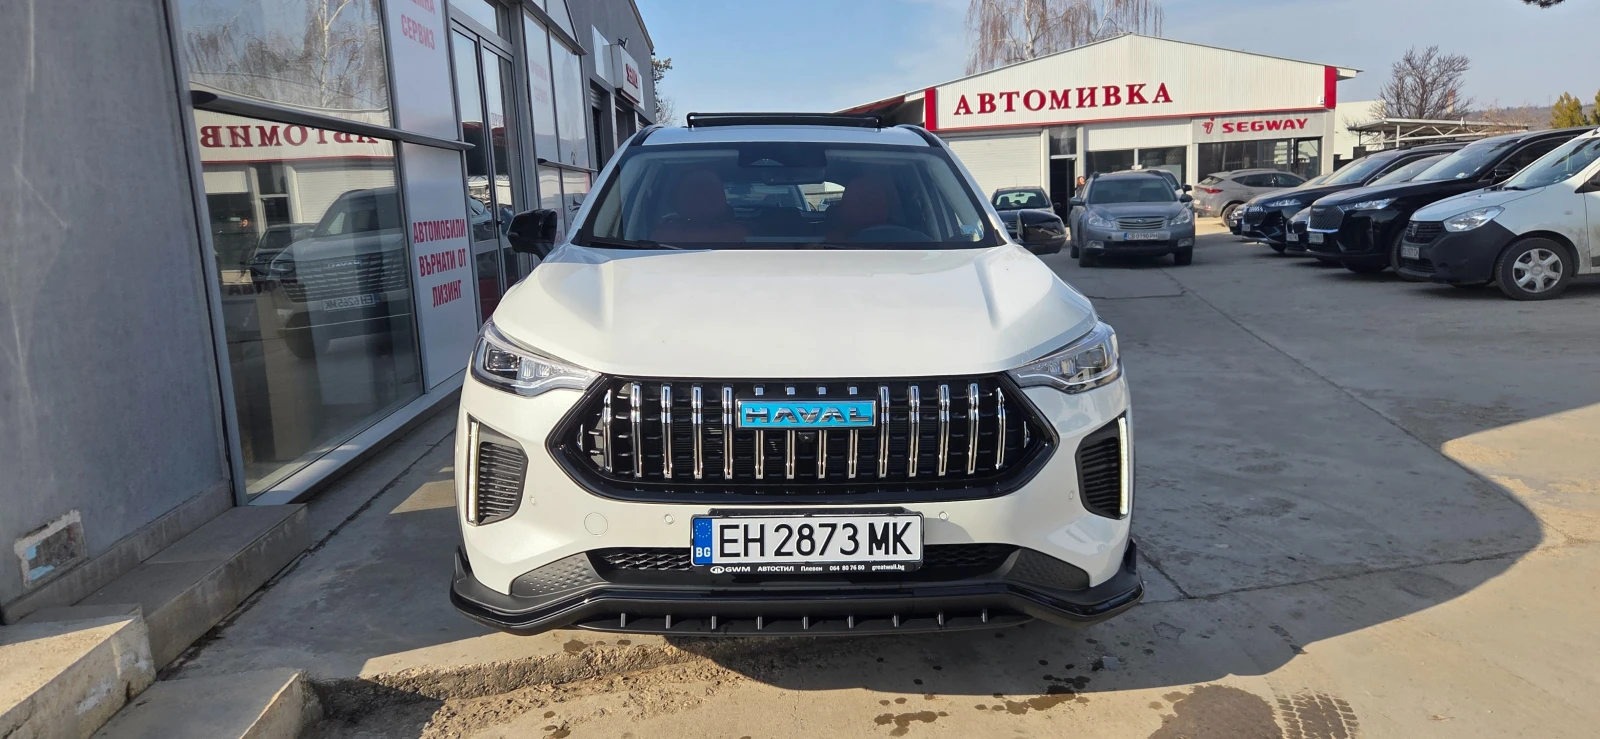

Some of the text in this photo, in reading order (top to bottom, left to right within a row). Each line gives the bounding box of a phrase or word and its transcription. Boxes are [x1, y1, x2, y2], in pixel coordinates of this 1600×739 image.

[401, 13, 435, 50] СЕРВИЗ
[954, 82, 1173, 115] АВТОМИВКА
[1222, 118, 1308, 133] SEGWAY
[413, 219, 466, 243] АВТОМОБИЛИ
[419, 248, 467, 277] ВЪРНАТИ ОТ
[432, 279, 462, 308] ЛИЗИНГ
[745, 407, 870, 423] HAVAL
[695, 547, 711, 557] BG
[720, 521, 913, 557] EH 2873 MK
